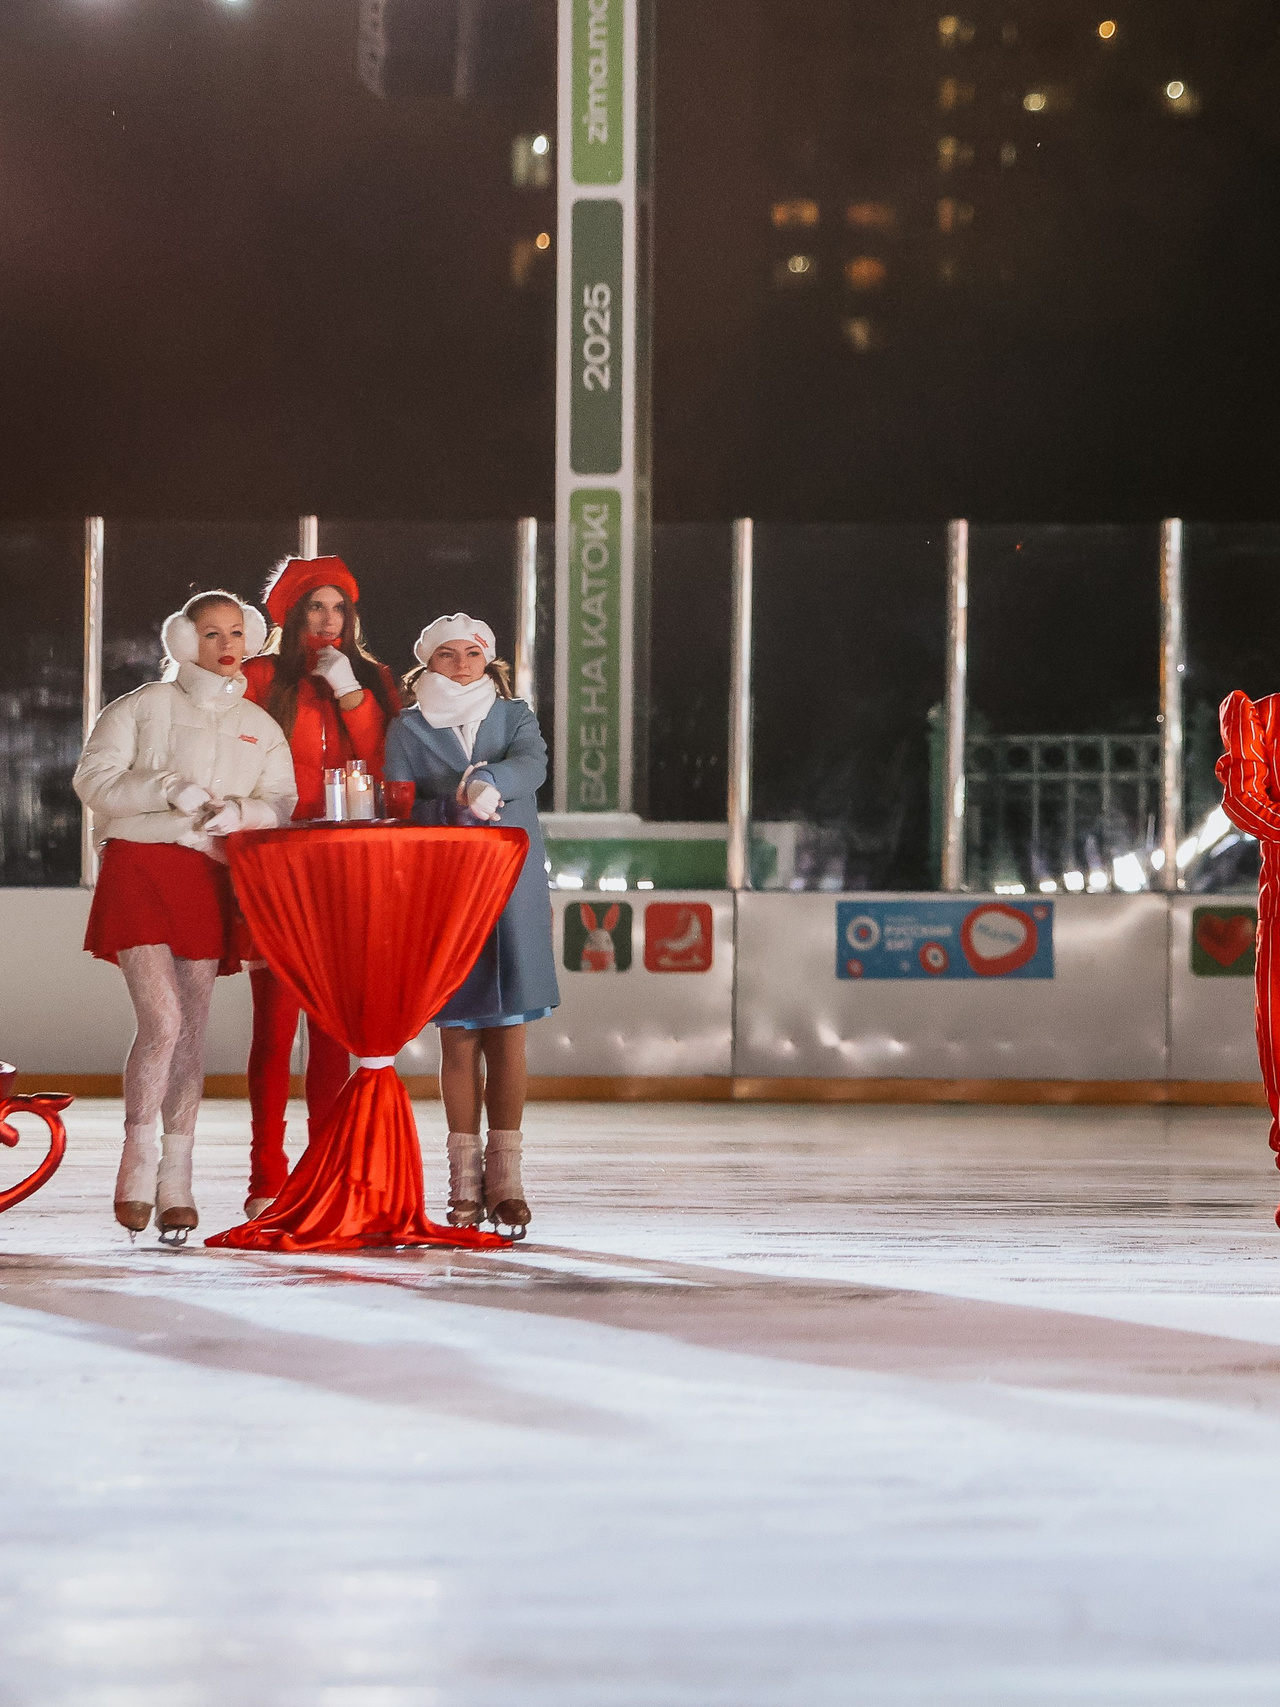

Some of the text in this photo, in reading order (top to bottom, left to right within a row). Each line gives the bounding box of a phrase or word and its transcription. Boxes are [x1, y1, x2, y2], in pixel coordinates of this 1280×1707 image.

[583, 282, 611, 391] 2025
[581, 656, 608, 715] НА
[579, 725, 607, 805] ВСЕ
